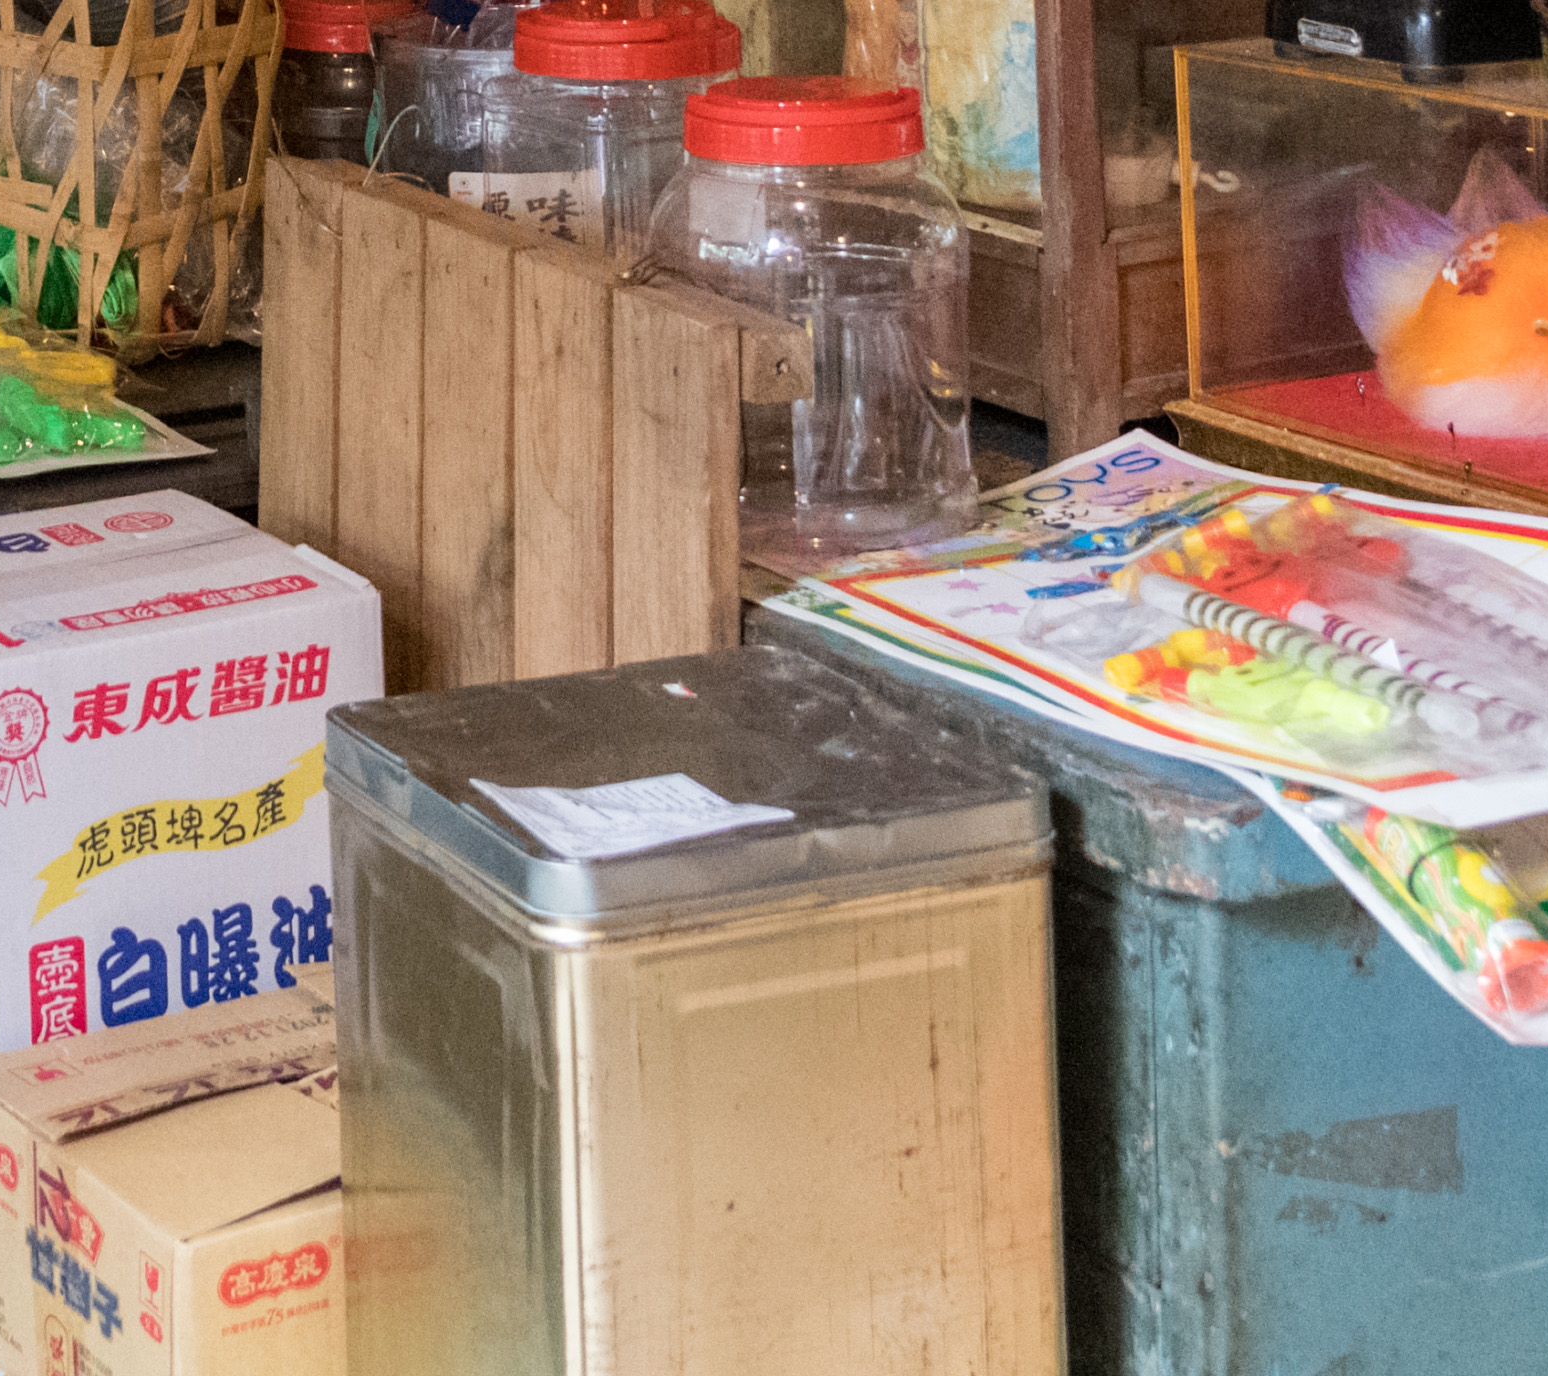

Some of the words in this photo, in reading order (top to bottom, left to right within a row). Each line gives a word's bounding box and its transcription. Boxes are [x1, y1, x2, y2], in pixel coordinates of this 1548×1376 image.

[481, 189, 580, 225] 原味
[978, 450, 1162, 514] TOYS
[63, 642, 332, 745] 東成醬油
[76, 778, 289, 881] 虎頭埤名產
[33, 943, 82, 1045] 壺底
[228, 1250, 323, 1300] 高慶泉
